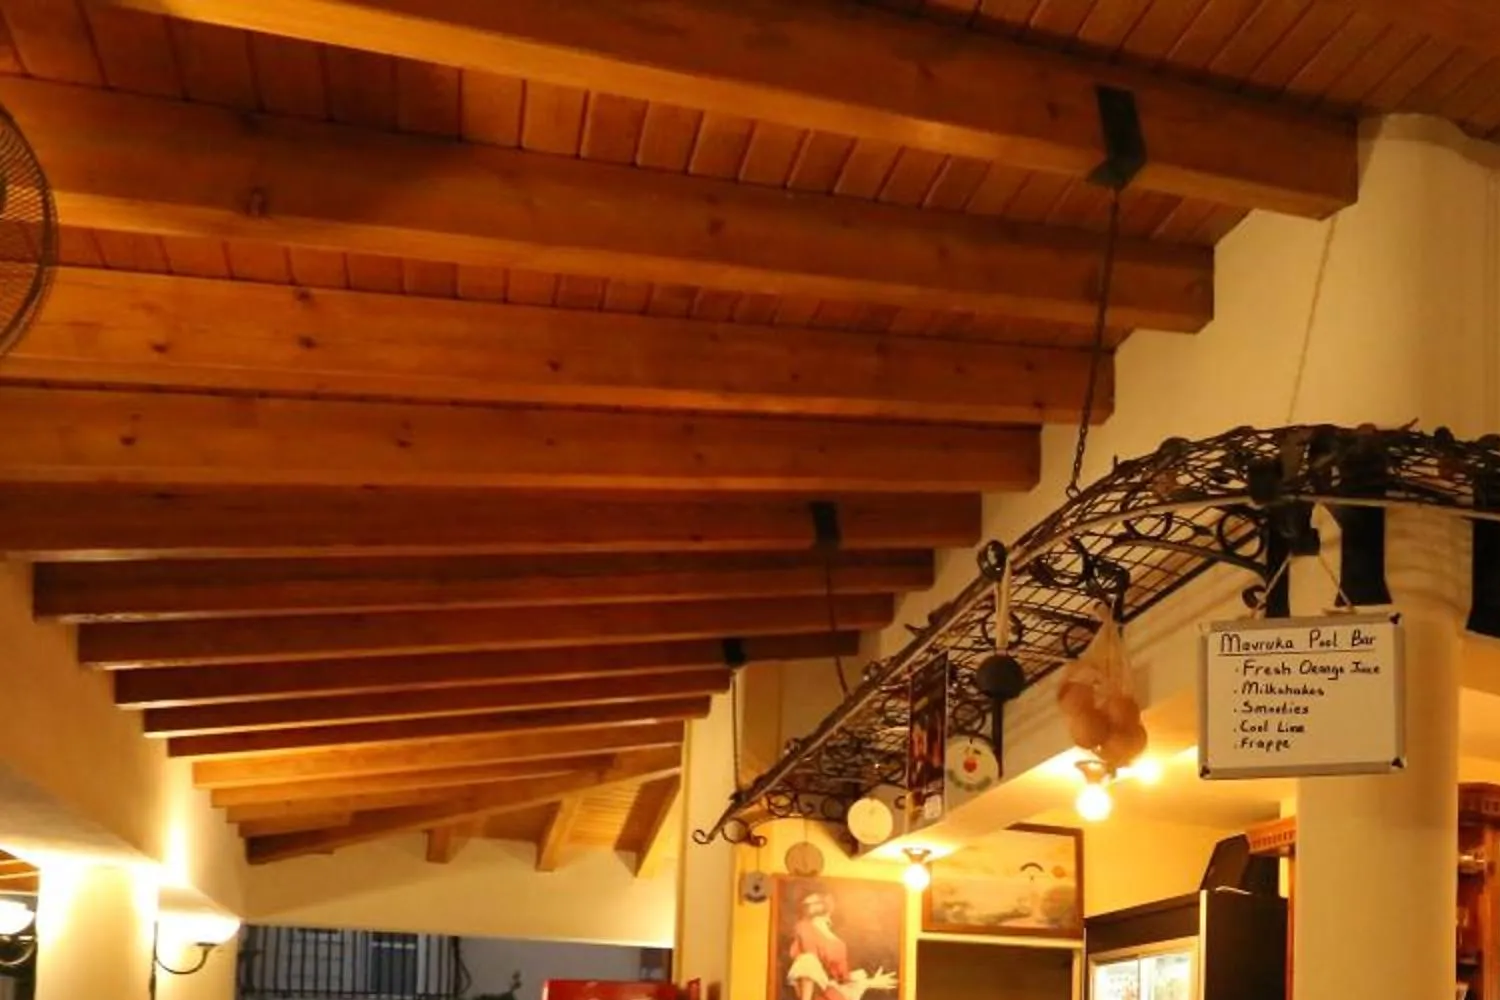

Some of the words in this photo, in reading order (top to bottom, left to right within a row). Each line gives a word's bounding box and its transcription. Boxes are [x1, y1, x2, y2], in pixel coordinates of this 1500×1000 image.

[1309, 629, 1338, 648] Pool
[1351, 629, 1376, 647] Bar
[1243, 659, 1291, 676] Fresh
[1240, 719, 1268, 733] Cool
[1241, 737, 1290, 752] Frappe
